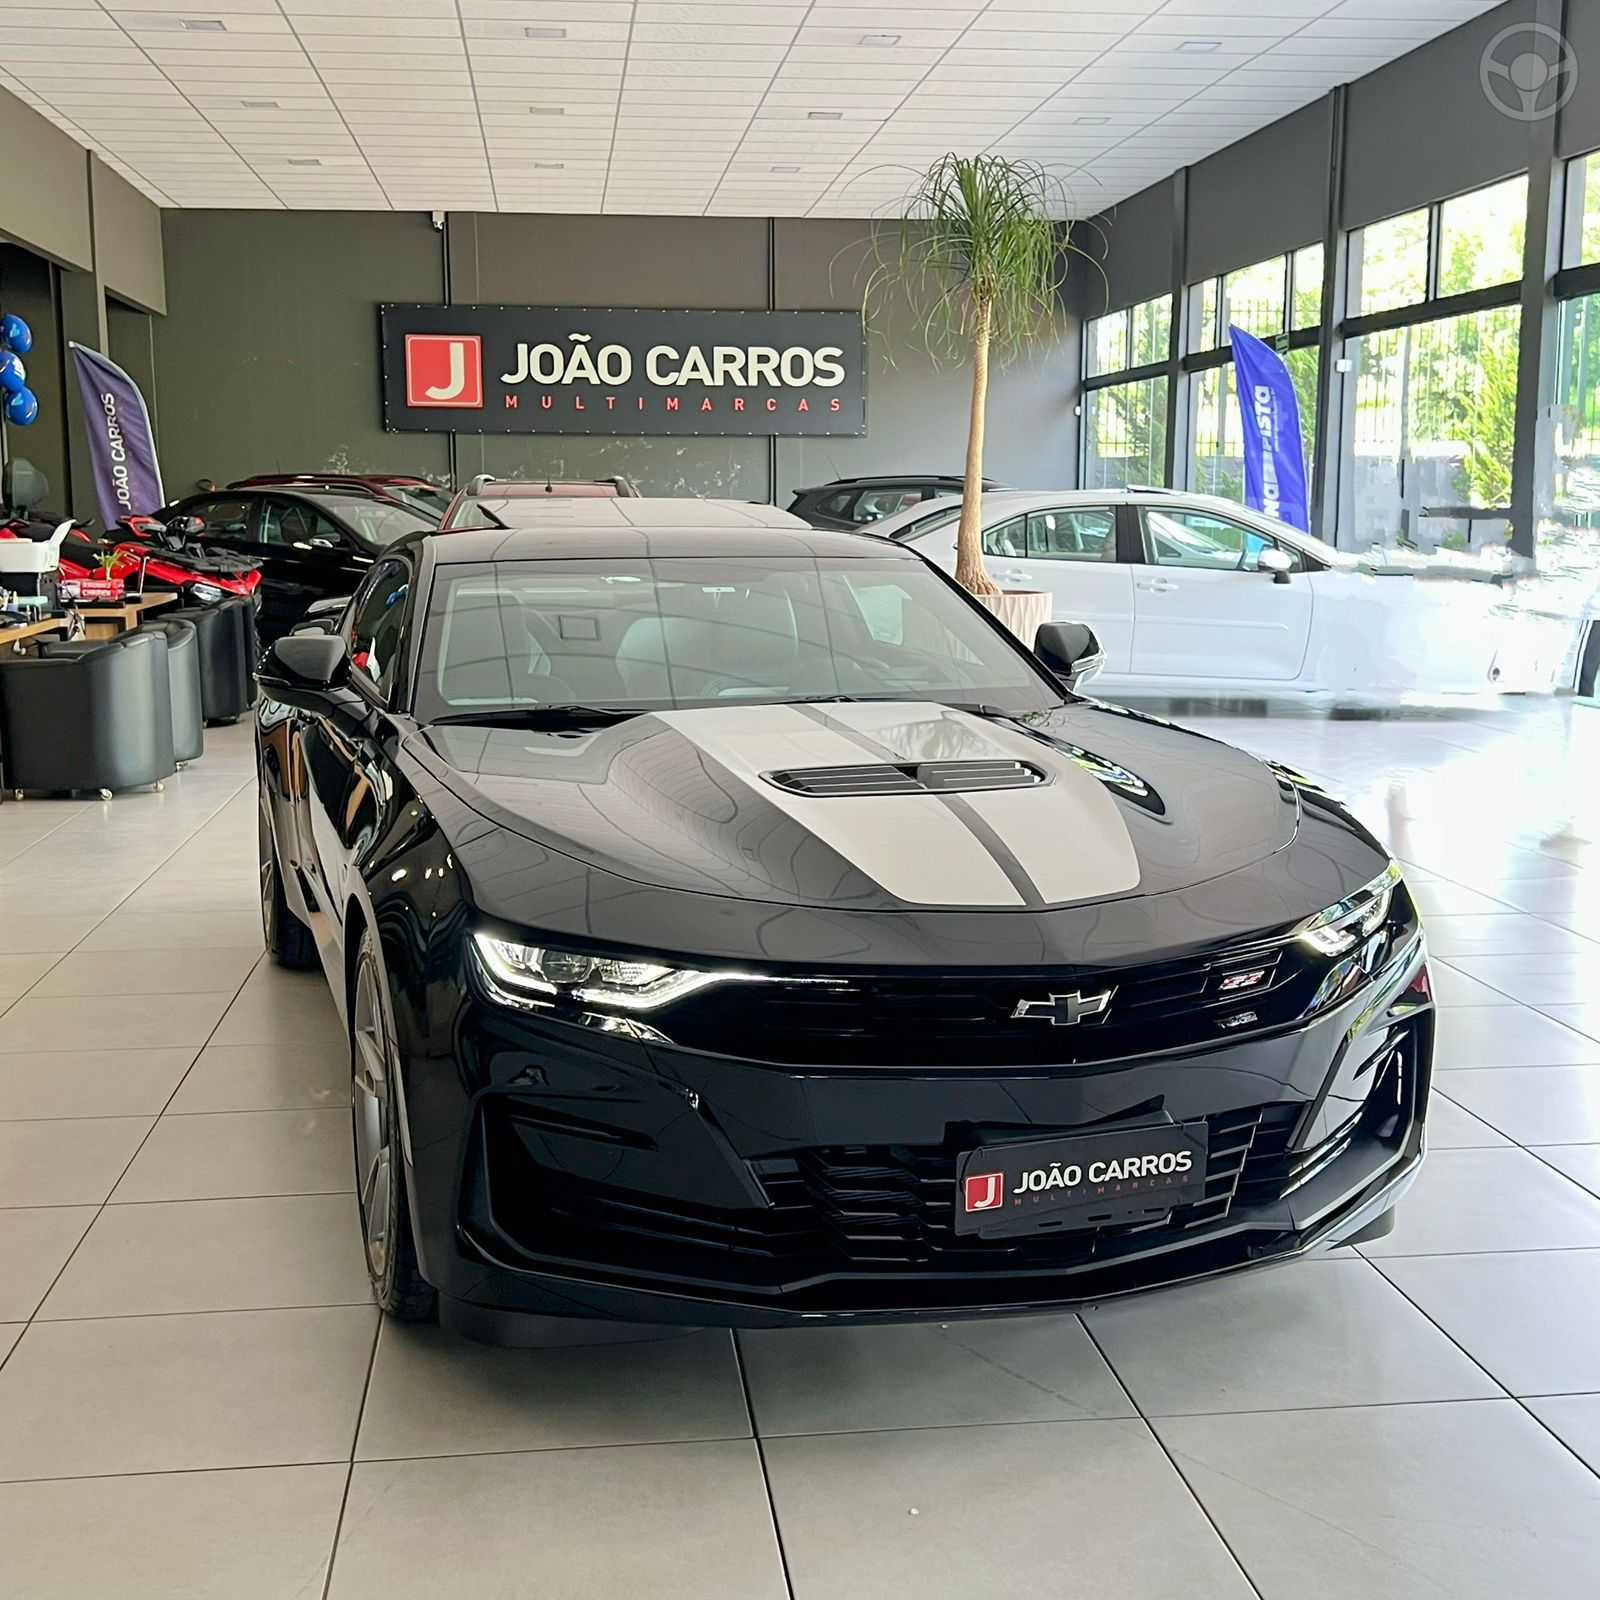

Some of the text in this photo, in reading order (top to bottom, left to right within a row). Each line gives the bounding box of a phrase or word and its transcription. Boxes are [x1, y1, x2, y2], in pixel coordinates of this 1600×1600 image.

[424, 342, 465, 401] J
[500, 332, 846, 388] JOÃO CARROS
[505, 395, 842, 412] MULTIMARCAS
[101, 392, 126, 462] CARROS
[112, 464, 132, 510] JOÃO
[974, 1176, 996, 1208] J
[1013, 1150, 1193, 1194] JOÃO CARROS
